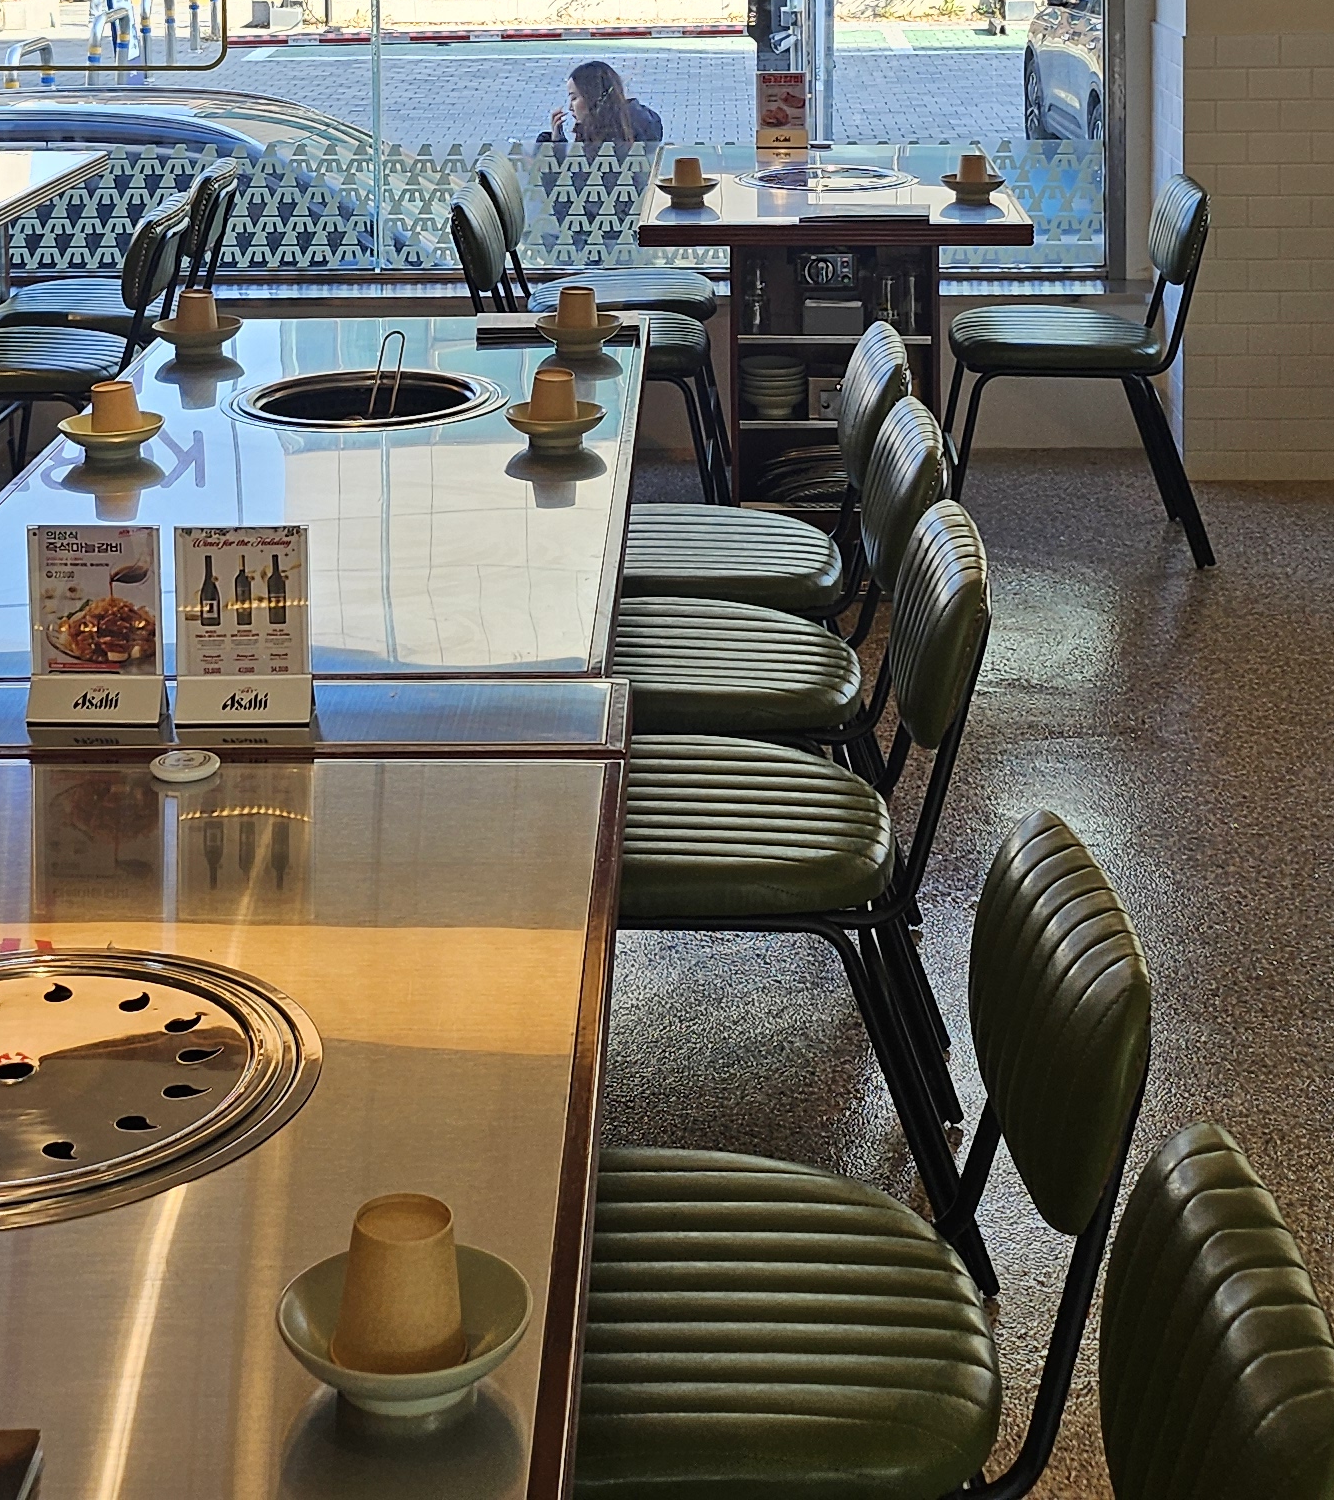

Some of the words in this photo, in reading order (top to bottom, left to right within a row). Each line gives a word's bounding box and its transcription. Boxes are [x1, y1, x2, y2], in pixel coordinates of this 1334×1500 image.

[45, 530, 79, 541] 의성식
[45, 541, 123, 554] 즉석마늘갈비
[192, 537, 219, 548] Wines
[218, 539, 235, 549] for
[235, 539, 250, 547] the
[251, 536, 292, 548] Holiday
[72, 691, 121, 711] Asahi
[221, 692, 269, 711] Asahi
